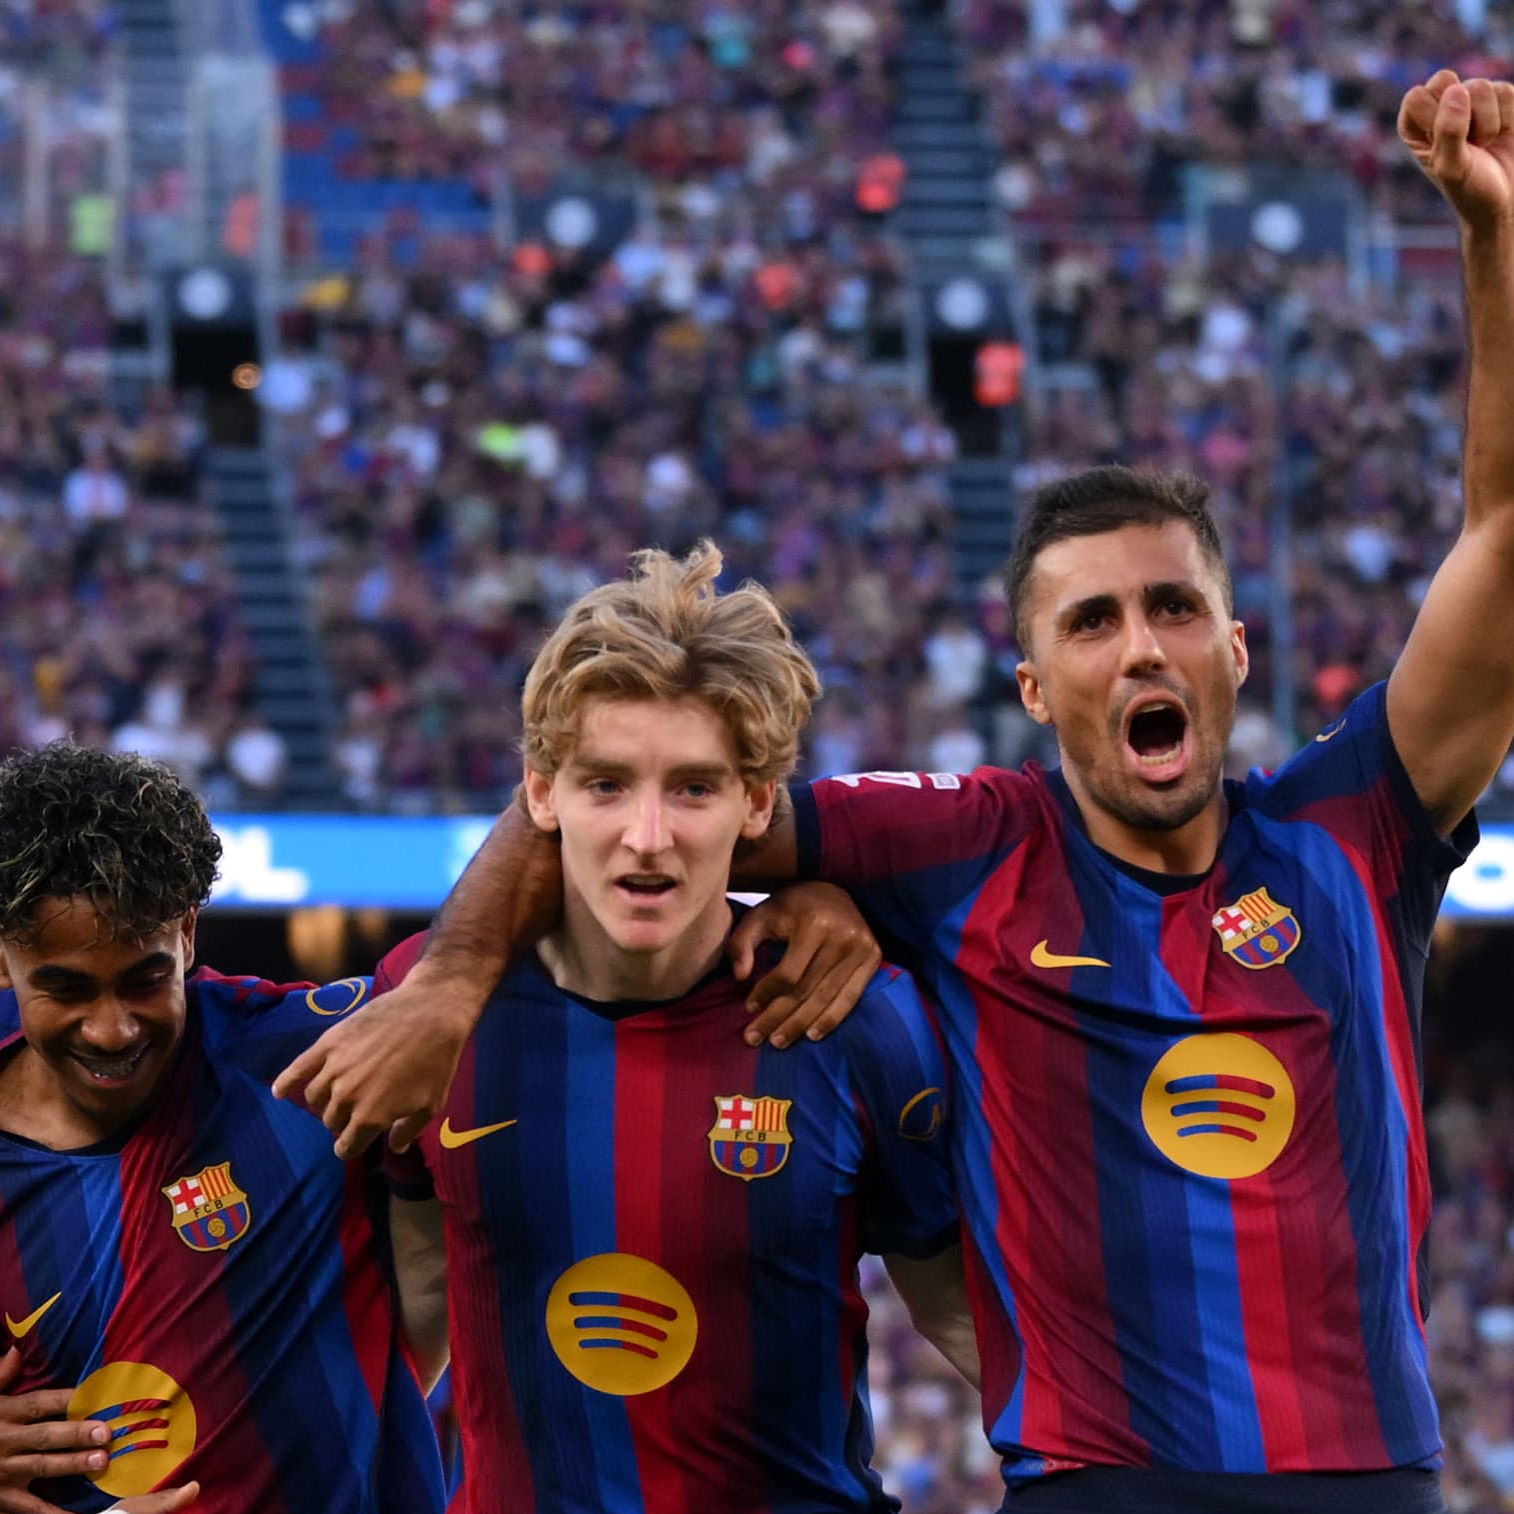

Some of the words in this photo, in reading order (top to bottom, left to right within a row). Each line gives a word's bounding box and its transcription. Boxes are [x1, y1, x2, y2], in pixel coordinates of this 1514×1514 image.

[1242, 918, 1271, 940] FCB
[734, 1130, 767, 1142] FCB
[193, 1199, 224, 1218] FCB
